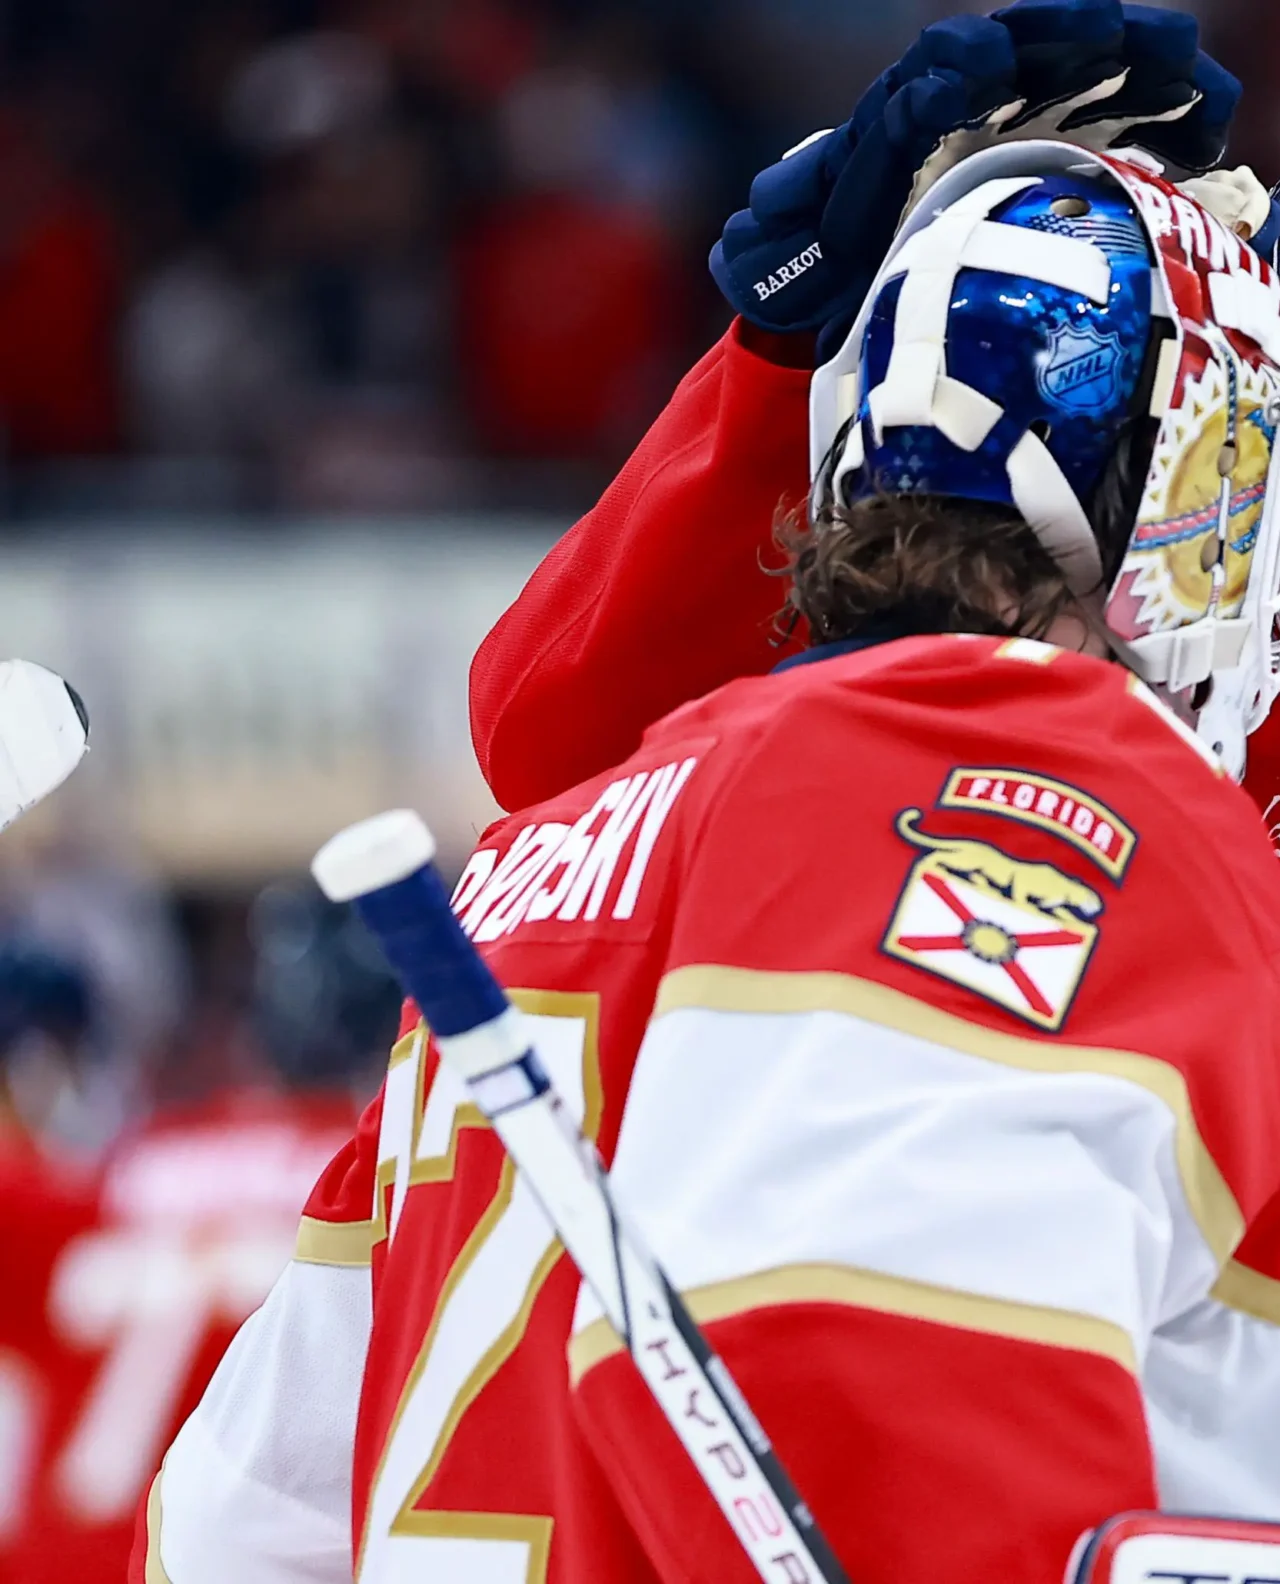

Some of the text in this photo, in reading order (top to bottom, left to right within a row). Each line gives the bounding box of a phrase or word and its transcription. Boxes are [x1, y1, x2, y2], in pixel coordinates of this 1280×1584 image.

[752, 241, 823, 301] BARKOV
[1054, 355, 1106, 391] NHL
[967, 778, 1115, 853] FLORIDA
